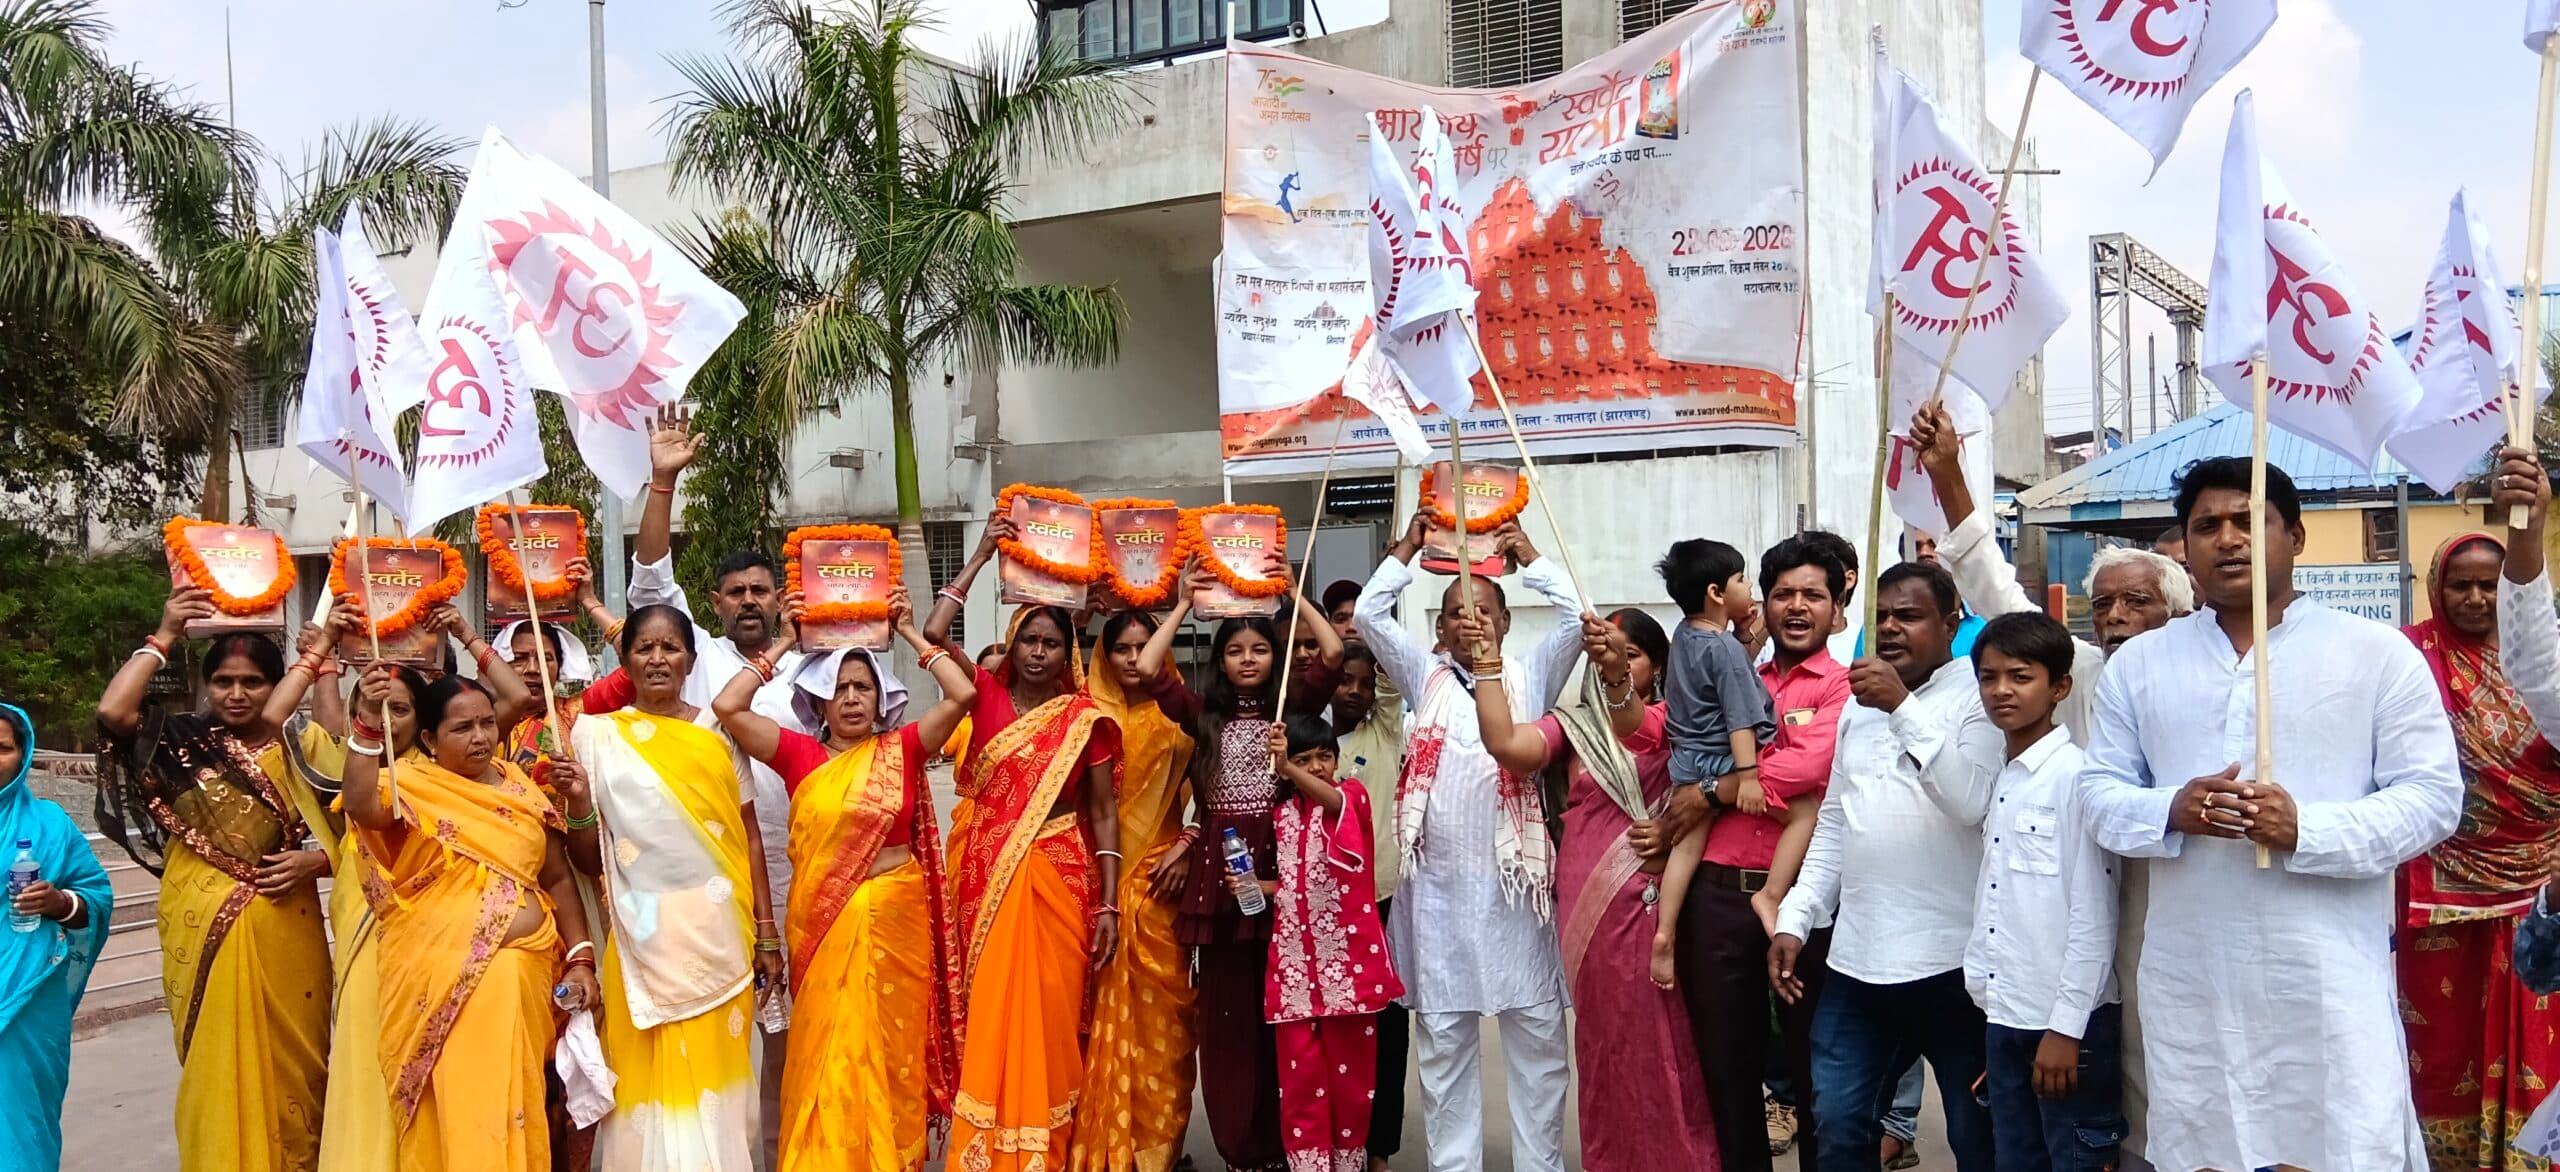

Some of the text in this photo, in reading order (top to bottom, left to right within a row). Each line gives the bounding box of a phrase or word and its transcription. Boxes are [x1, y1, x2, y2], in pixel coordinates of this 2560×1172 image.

[1114, 528, 1166, 546] स्वर्वेद
[1211, 533, 1265, 550] स्वर्वेद
[816, 560, 876, 579] स्वर्वेद
